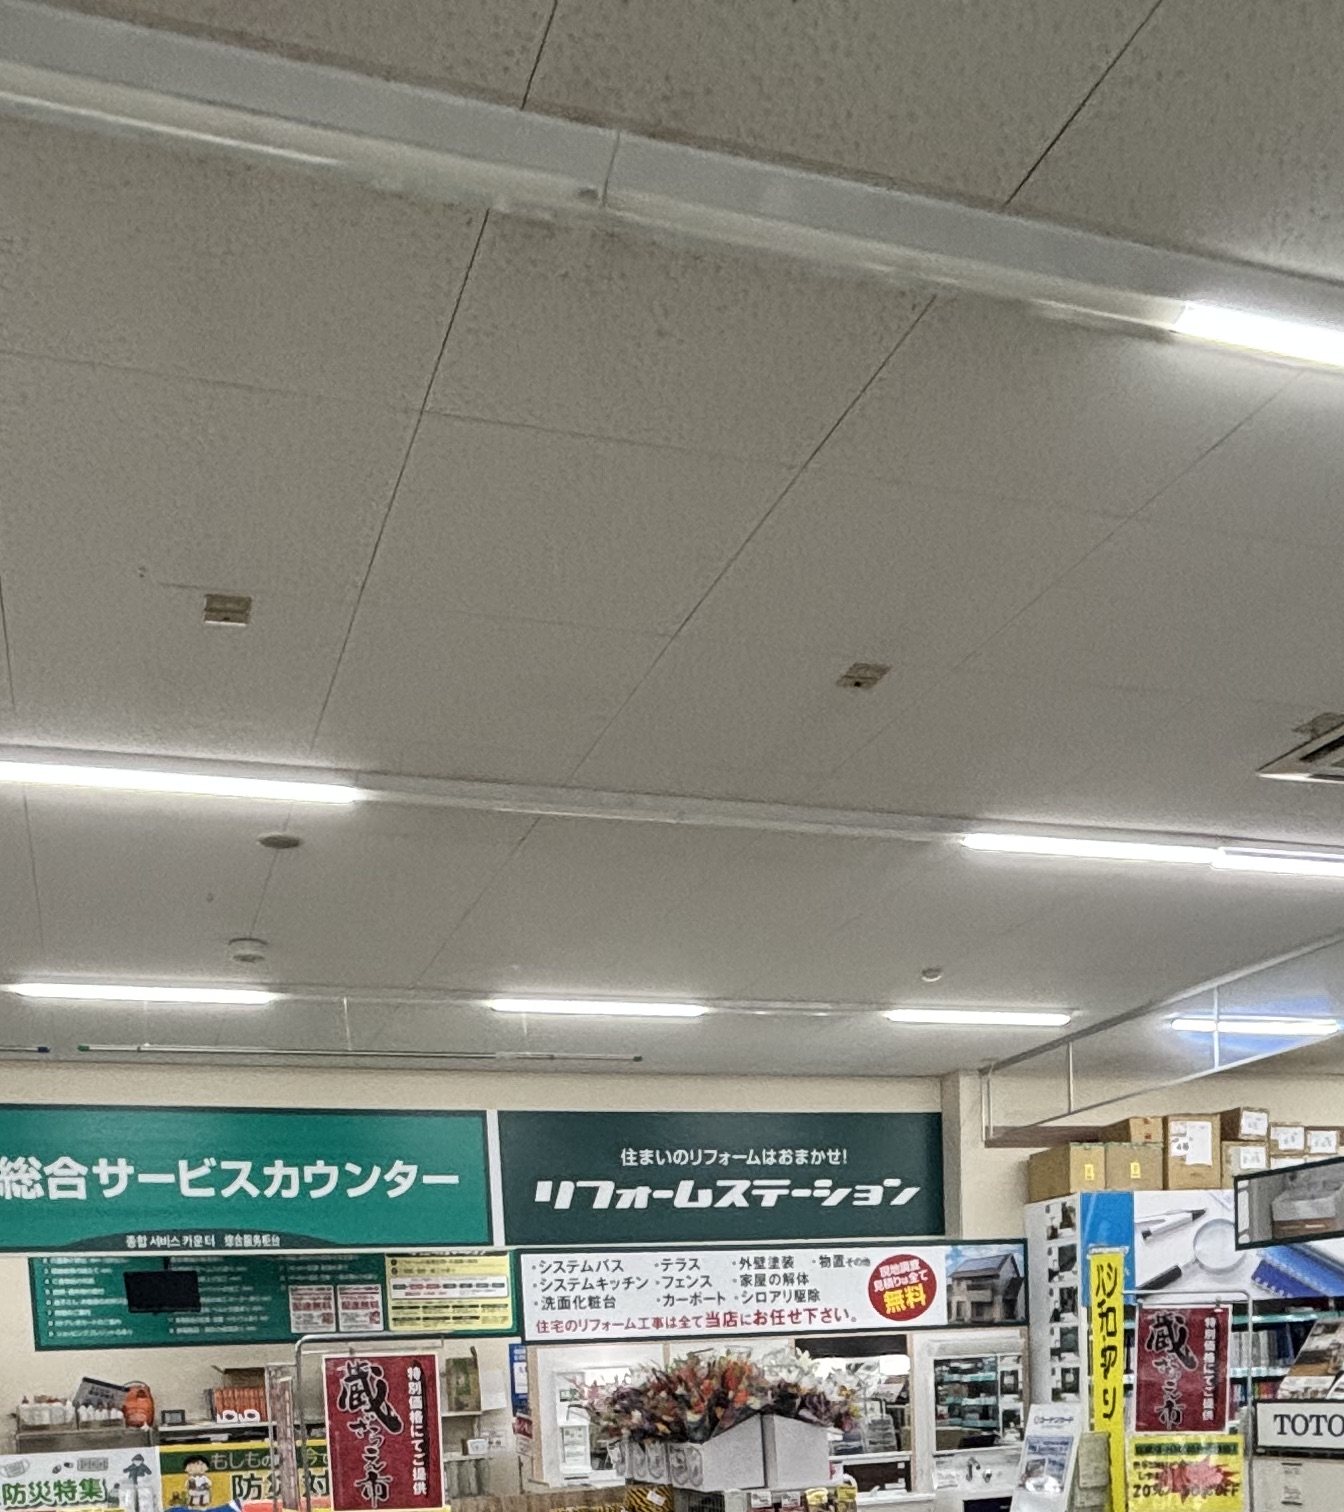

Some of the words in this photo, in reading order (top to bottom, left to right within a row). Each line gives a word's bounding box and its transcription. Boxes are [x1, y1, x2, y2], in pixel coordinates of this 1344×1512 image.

[535, 1178, 922, 1210] リフォームステーション
[539, 1259, 625, 1274] システムバス
[661, 1258, 701, 1271] テラス
[739, 1256, 795, 1270] 外壁塗装
[539, 1274, 649, 1291] システムキッチン
[662, 1275, 713, 1288] フェンス
[739, 1272, 810, 1287] 家屋の解体
[541, 1295, 617, 1310] 洗面化粧台
[662, 1291, 726, 1307] カーポート
[741, 1289, 821, 1305] シロアリ駆除
[883, 1285, 927, 1316] 無料
[536, 1306, 858, 1334] 住宅のリフォーム工事は全て当店にお任せ下さい。
[406, 1364, 429, 1497] 特別価格にてご提供
